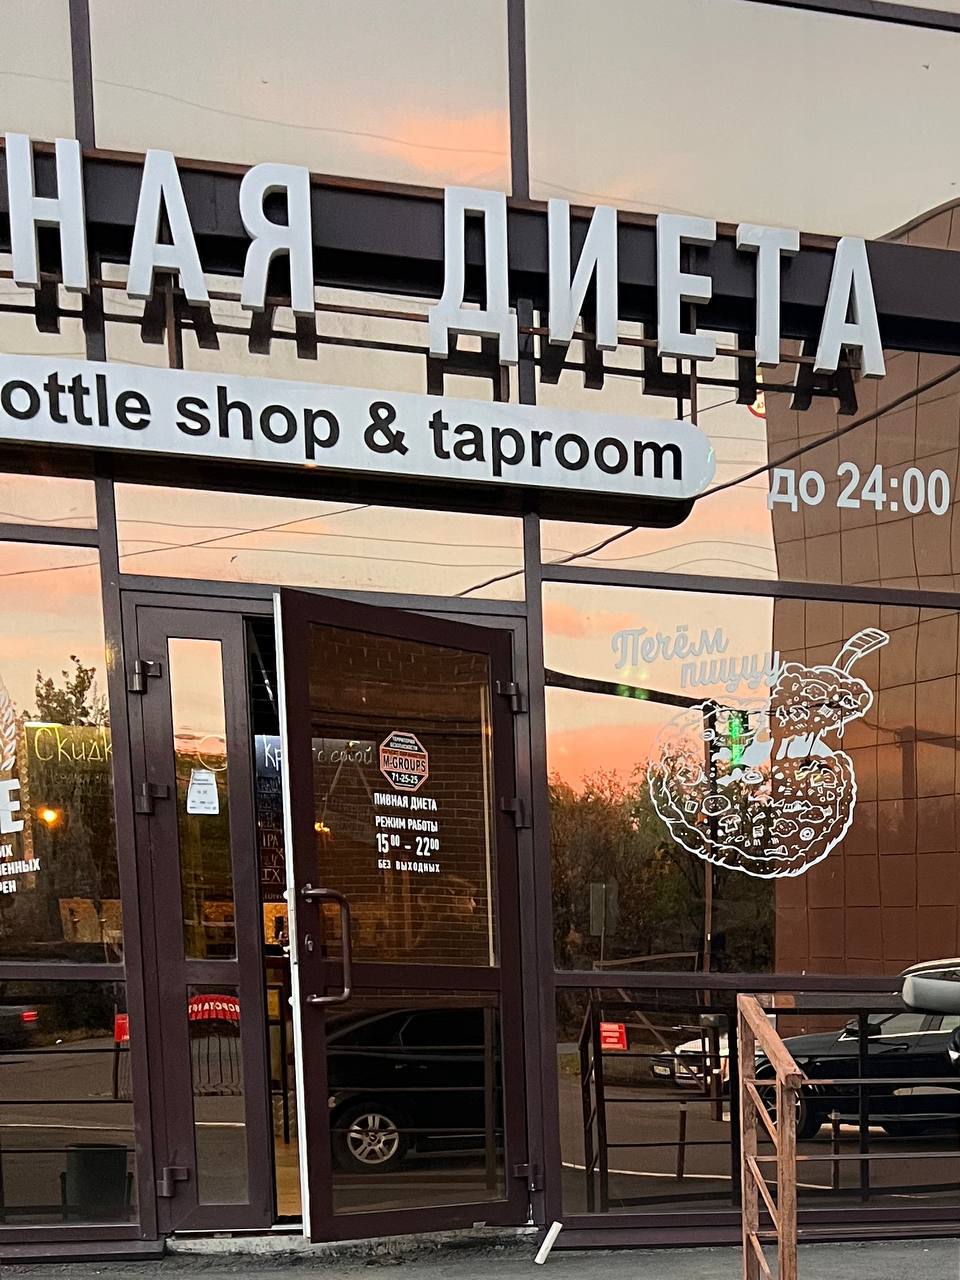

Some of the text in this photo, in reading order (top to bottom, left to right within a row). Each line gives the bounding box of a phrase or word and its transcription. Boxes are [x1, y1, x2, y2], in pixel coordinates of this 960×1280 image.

[429, 186, 887, 379] ДИЕТА
[1, 371, 683, 480] ottle shop & taproom
[768, 462, 950, 515] до 24:00
[611, 624, 729, 669] Печём
[681, 651, 782, 693] пиццу
[383, 755, 426, 772] M-GROUPS
[374, 792, 438, 811] ПИВНАЯ ДИЕТА
[375, 815, 438, 833] РЕЖИМ РАБОТЫ
[378, 859, 440, 875] БЕЗ ВЫХОДНЫХ
